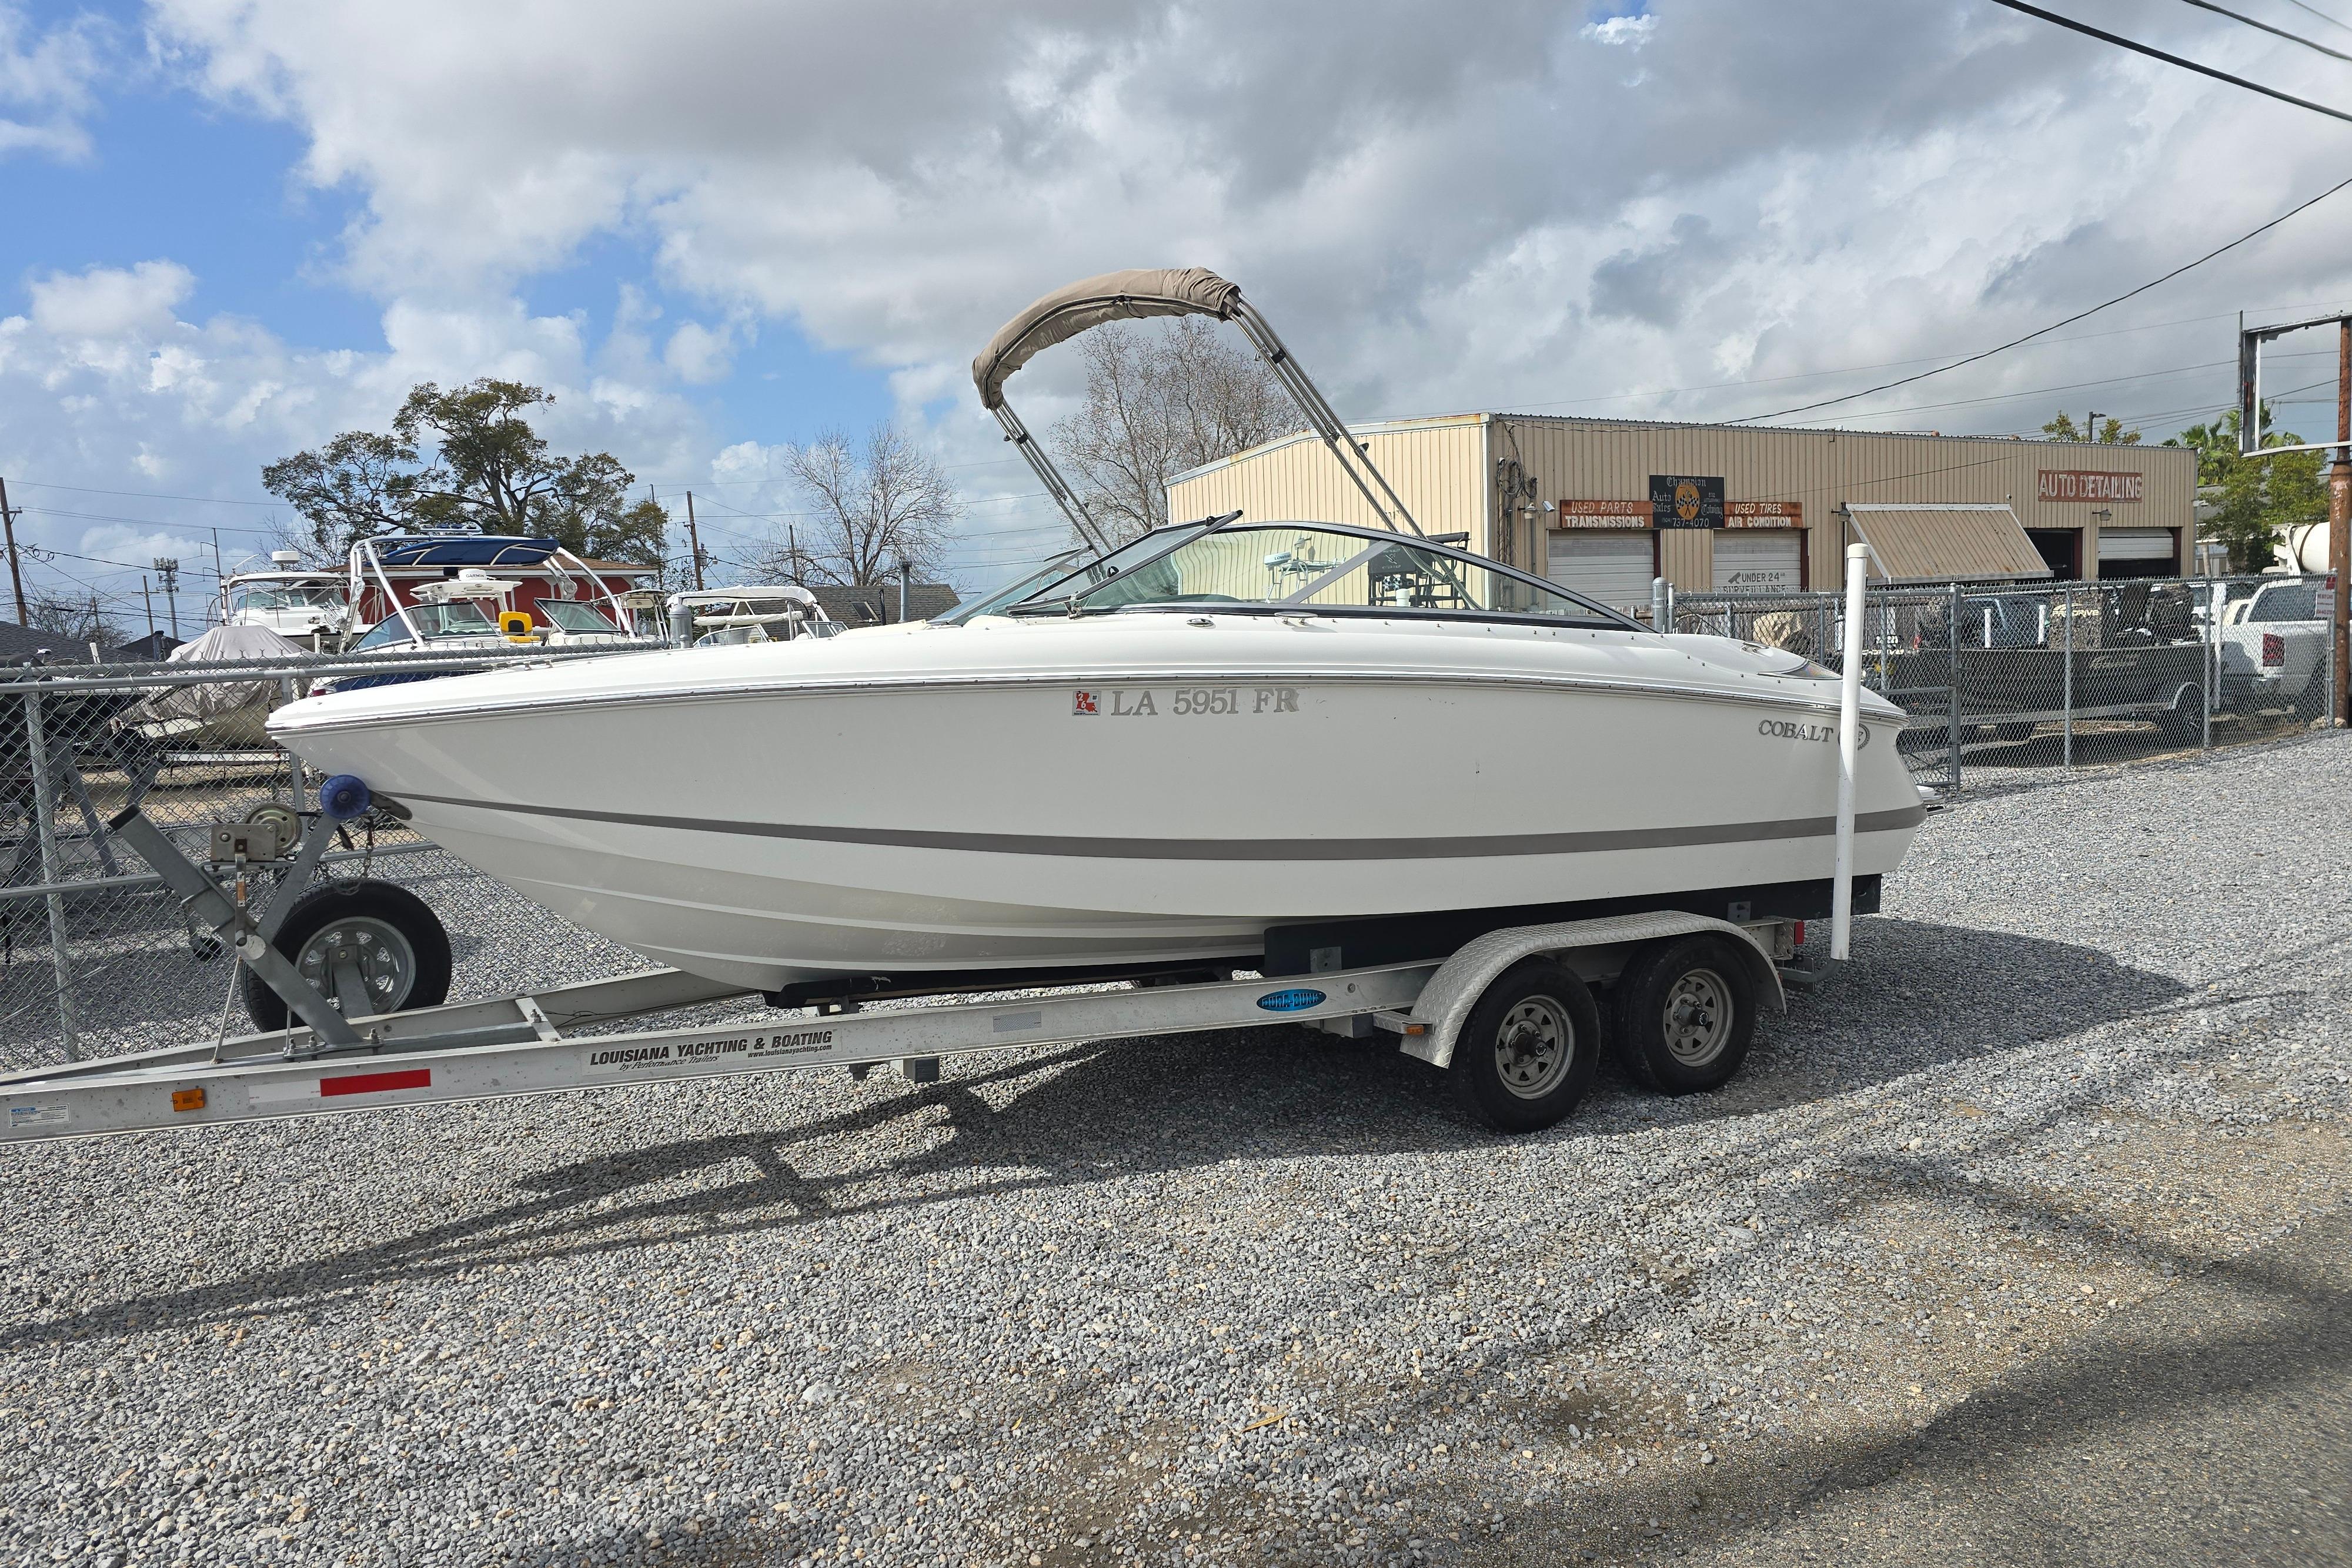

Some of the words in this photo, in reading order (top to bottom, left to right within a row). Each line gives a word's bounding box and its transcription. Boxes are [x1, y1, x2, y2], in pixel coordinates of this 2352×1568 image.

[1666, 476, 1706, 487] Champion
[2038, 473, 2076, 497] AUTO
[2079, 475, 2142, 499] DETAILING
[1652, 490, 1671, 501] Auto
[1572, 502, 1595, 513] USED
[1600, 502, 1633, 514] PARTS
[1735, 503, 1755, 514] USED
[1760, 503, 1782, 514] TIRES
[1565, 516, 1645, 527] TRANSMISSIONS
[1672, 518, 1709, 527] 737-4070
[1729, 517, 1742, 527] AIR
[1747, 517, 1791, 527] CONDITION
[1742, 573, 1766, 582] UNDER
[1111, 690, 1158, 716] LA
[1173, 688, 1239, 715] 5951
[1253, 688, 1299, 713] FR
[1758, 719, 1834, 742] COBALT
[1262, 992, 1319, 1007] DURA-BUNK
[590, 1046, 669, 1065] LOUISIANA
[677, 1039, 748, 1057] YACHTING
[753, 1037, 765, 1049] &
[771, 1031, 832, 1048] BOATING
[747, 1045, 832, 1058] www.louisianayachting.com
[619, 1063, 632, 1072] by
[631, 1059, 687, 1069] Performance
[687, 1055, 720, 1064] Trailers
